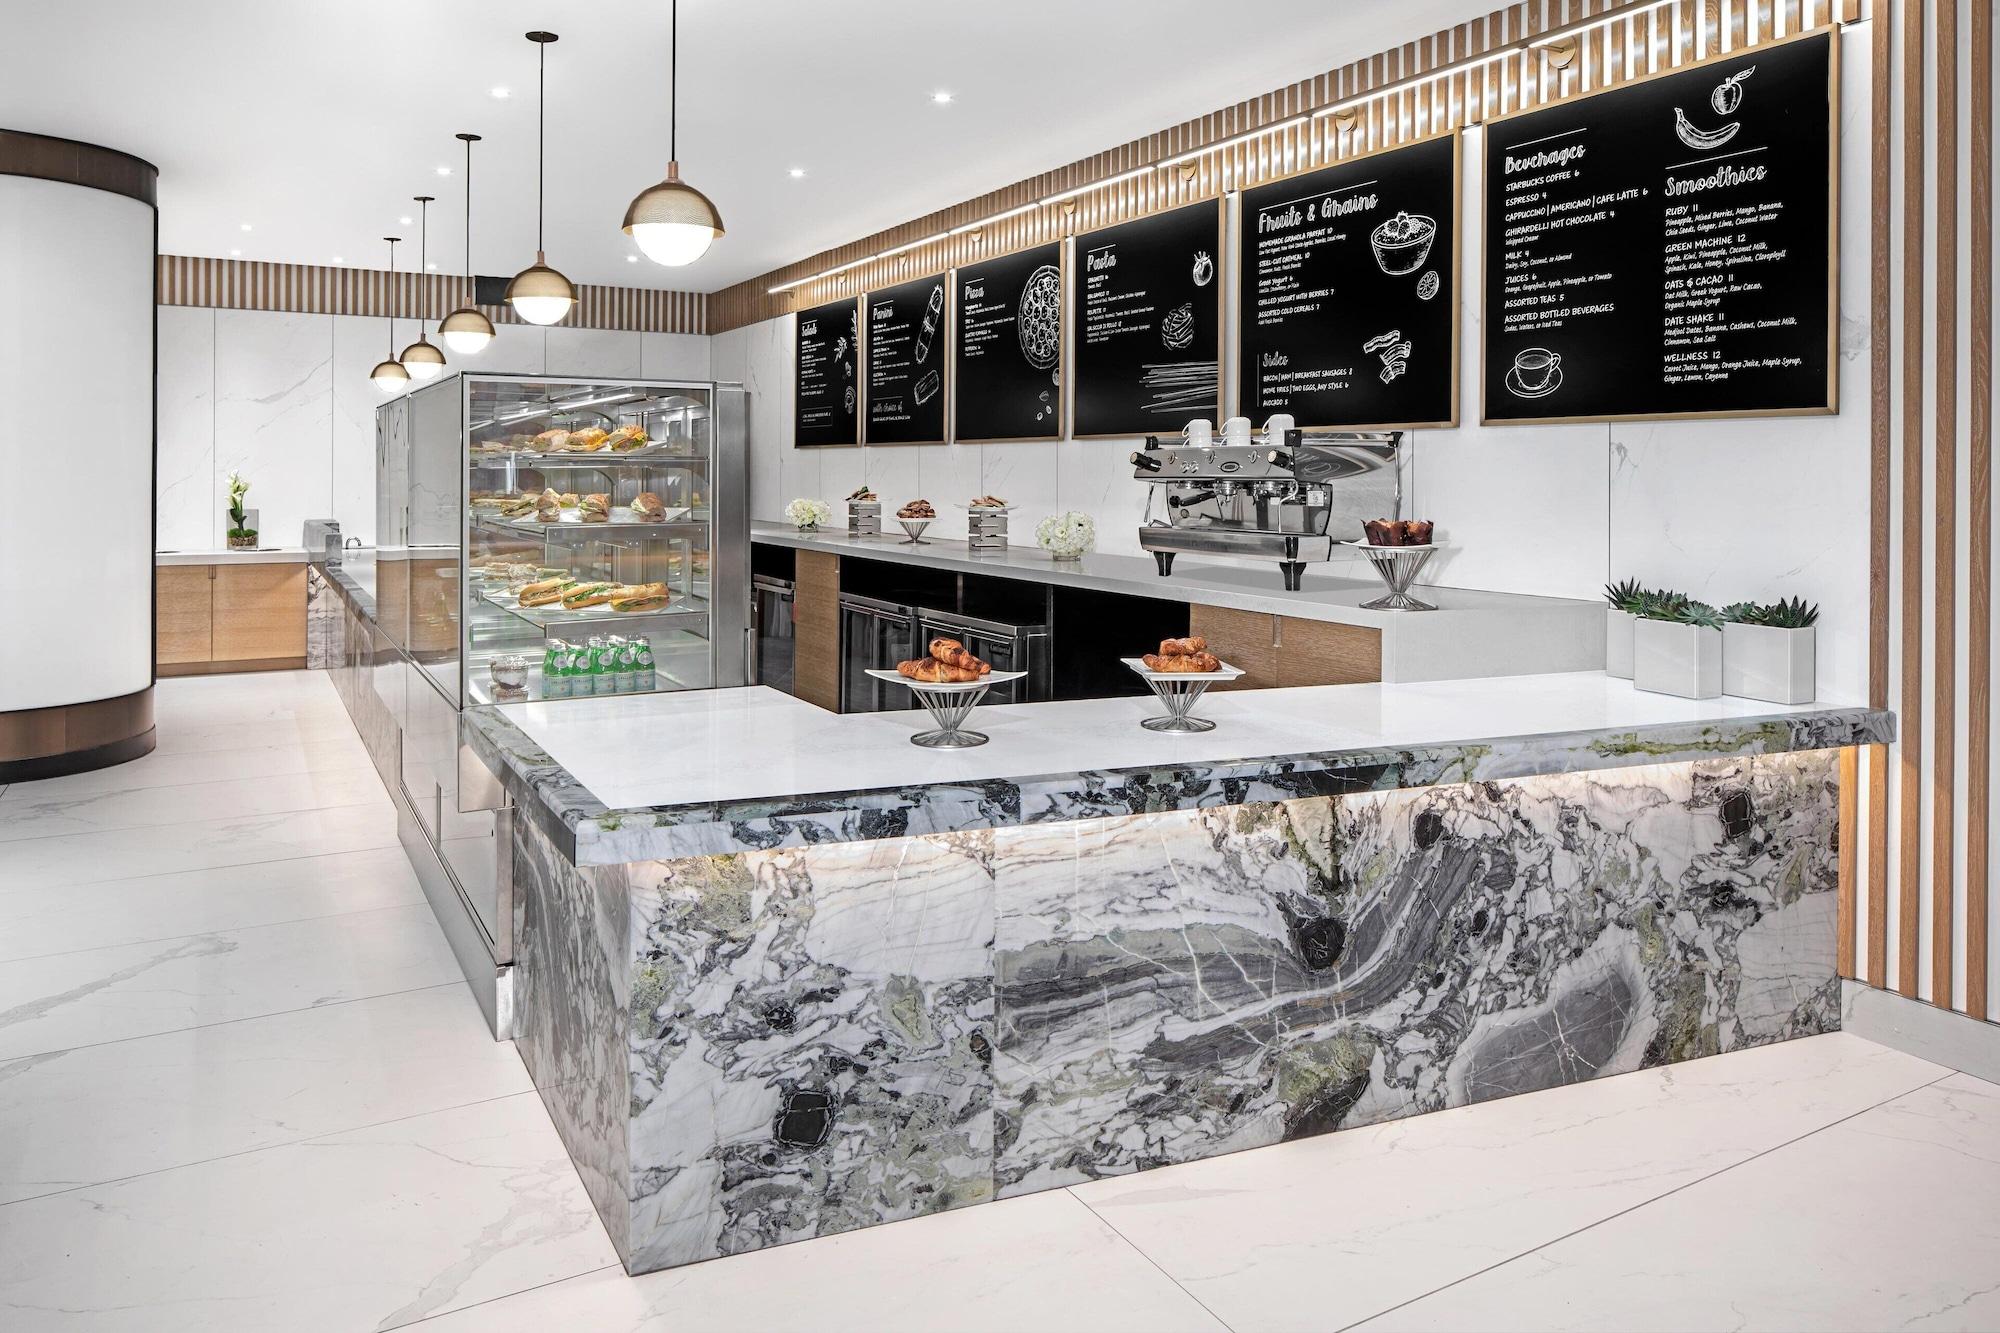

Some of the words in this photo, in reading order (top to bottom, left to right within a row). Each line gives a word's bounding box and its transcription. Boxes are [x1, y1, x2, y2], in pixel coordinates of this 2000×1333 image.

[1505, 145, 1586, 174] Beverages
[1506, 177, 1544, 191] STARBUCKS
[1546, 171, 1571, 183] COFFEE
[1665, 166, 1767, 196] Smoothies
[1505, 208, 1545, 222] CAPPUCCINO
[1551, 199, 1590, 214] AMERICANO
[1597, 194, 1614, 204] CAFE
[1617, 189, 1638, 200] LATTE
[1506, 193, 1539, 206] ESPRESSO
[1258, 206, 1302, 234] Fruits
[1307, 204, 1315, 221] &
[1321, 194, 1378, 218] Grains
[1666, 206, 1688, 216] RUBY
[1666, 216, 1693, 227] Pineapple,
[1695, 212, 1711, 222] Mixed
[1712, 210, 1734, 219] Berries,
[1736, 206, 1756, 215] Mango,
[1758, 202, 1783, 211] Banana,
[1505, 222, 1549, 237] GHIRARDELLI
[1551, 219, 1564, 229] HOT
[1566, 212, 1606, 226] CHOCOLATE
[1697, 223, 1717, 232] Ginger,
[1718, 220, 1733, 228] Lime,
[1735, 215, 1758, 225] Coconut
[1759, 213, 1778, 221] Water
[1284, 233, 1306, 244] GRANOLA
[1307, 228, 1326, 238] PARFAIT
[1524, 235, 1539, 243] Cream
[1665, 242, 1692, 253] GREEN
[1695, 236, 1732, 249] MACHINE
[1738, 234, 1746, 242] 12
[1506, 251, 1522, 260] MILK
[1555, 253, 1572, 261] Almond
[1665, 255, 1681, 264] Apple,
[1683, 252, 1697, 260] Kiwi,
[1699, 249, 1727, 259] Pineapple,
[1729, 245, 1752, 254] Coconut
[1753, 242, 1768, 250] Milk,
[1087, 251, 1116, 272] Pasta
[1665, 265, 1687, 274] Spinach,
[1689, 262, 1703, 270] Kale,
[1505, 274, 1528, 284] JUICES
[1665, 280, 1684, 290] OATS
[1696, 275, 1723, 286] CACAO
[965, 286, 984, 300] Pizza
[1708, 287, 1728, 296] Yogurt,
[1743, 283, 1762, 291] Cacao,
[1258, 298, 1277, 306] CHILLED
[1277, 294, 1295, 303] YOGURT
[1309, 289, 1328, 298] BERRIES
[1505, 297, 1538, 309] ASSORTED
[1540, 295, 1556, 304] TEAS
[1665, 302, 1684, 311] Organic
[1686, 299, 1702, 308] Maple
[1703, 298, 1720, 307] Syrup
[873, 306, 893, 320] Panini
[1258, 310, 1280, 318] ASSORTED
[1294, 305, 1314, 313] CEREALS
[1504, 313, 1538, 324] ASSORTED
[1540, 308, 1570, 320] BOTTLED
[1572, 303, 1614, 315] BEVERAGES
[1664, 327, 1685, 336] Medjool
[1686, 326, 1703, 334] Dates,
[1730, 322, 1755, 330] Cashews,
[1757, 319, 1780, 327] Coconut
[1781, 317, 1797, 325] Milk,
[1665, 316, 1684, 326] DATE
[1686, 313, 1714, 323] SHAKE
[1263, 351, 1288, 367] Sides
[1664, 352, 1708, 362] WELLNESS
[1713, 351, 1720, 359] 12
[1682, 364, 1698, 372] Juice,
[1700, 363, 1719, 371] Mango,
[1722, 361, 1741, 370] Orange
[1762, 359, 1780, 367] Maple
[1782, 357, 1801, 367] Syrup,
[1295, 371, 1320, 379] BREAKFAST
[1322, 368, 1346, 377] SAUSAGES
[1664, 375, 1683, 384] Ginger,
[1705, 373, 1728, 382] Cayenne
[1263, 386, 1275, 394] HOME
[1277, 385, 1289, 393] FRIES
[1303, 384, 1316, 392] EGGS,
[1317, 383, 1326, 391] ANY
[1328, 382, 1342, 390] STYLE
